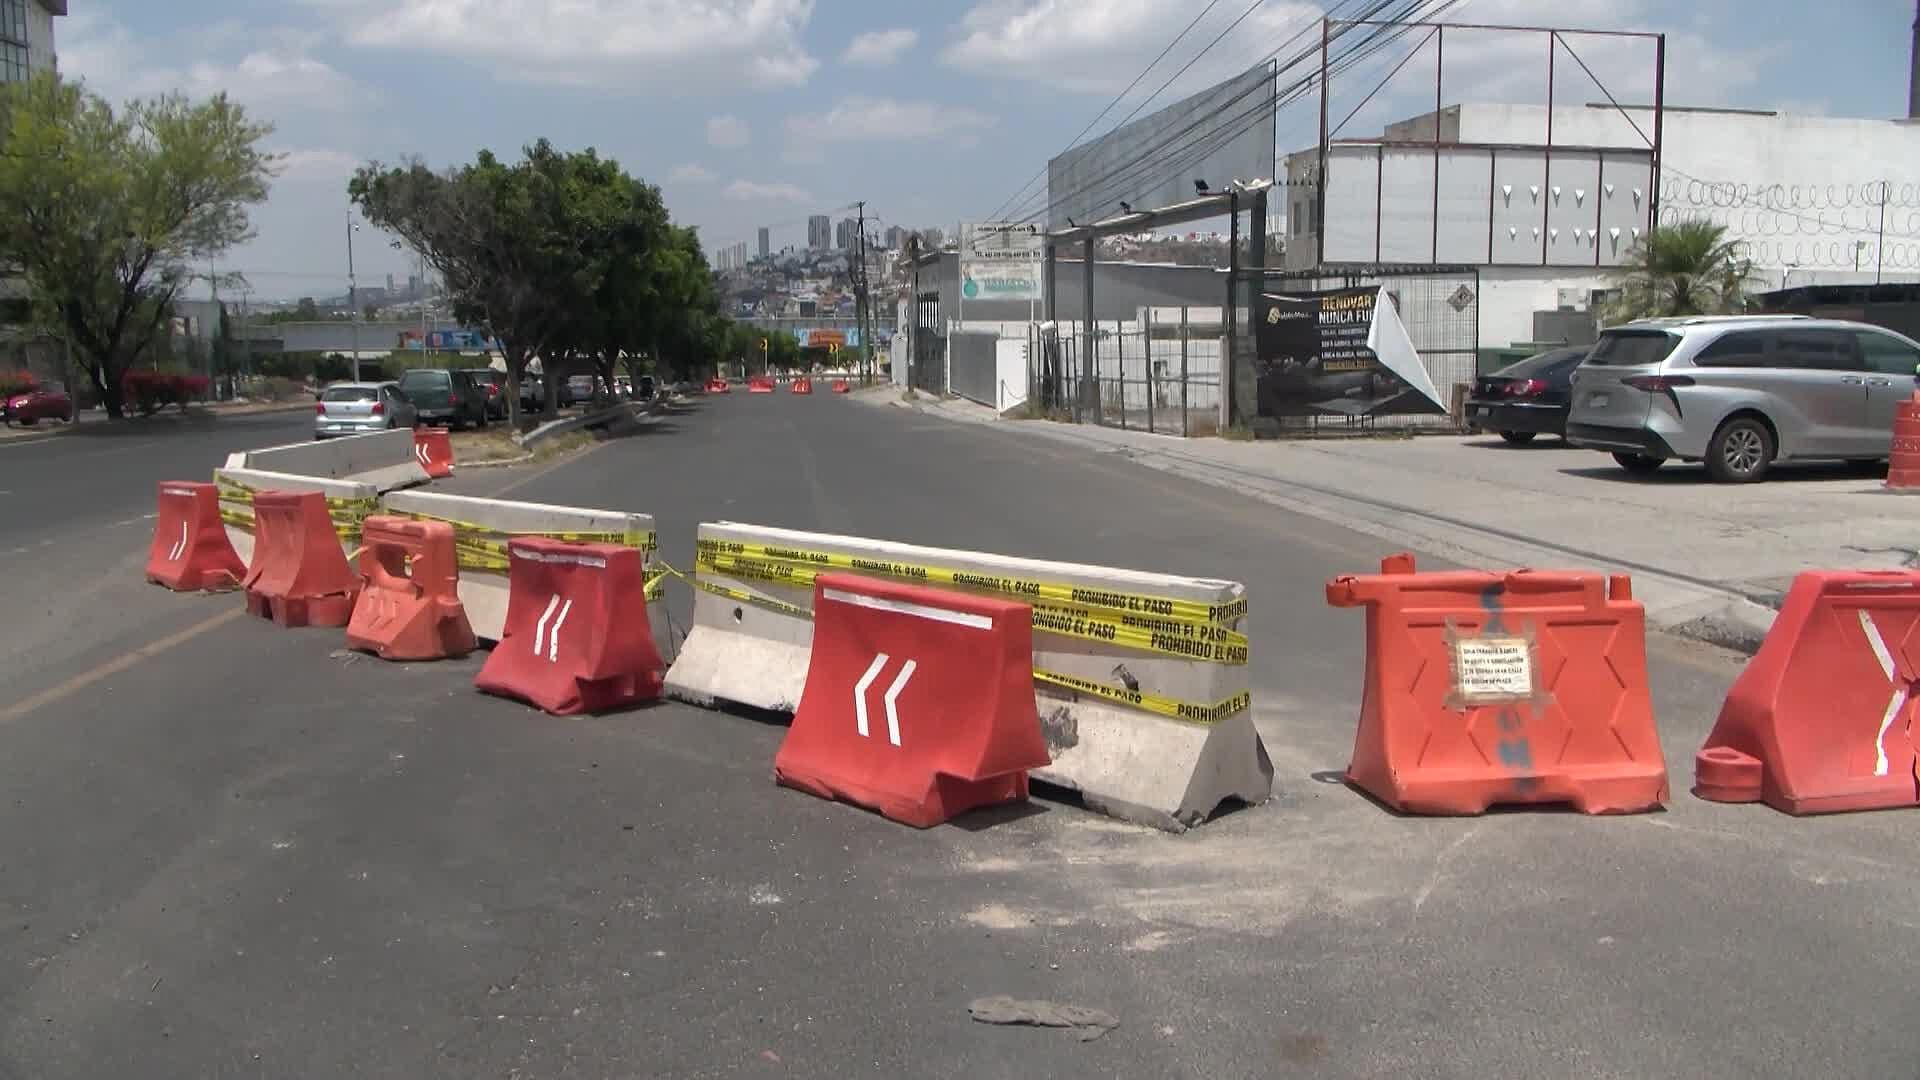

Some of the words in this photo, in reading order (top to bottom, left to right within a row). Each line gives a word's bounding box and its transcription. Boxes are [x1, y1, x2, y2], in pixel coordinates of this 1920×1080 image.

[1322, 295, 1371, 310] RENOVAR
[1318, 311, 1353, 324] NUNCA
[1072, 588, 1127, 609] PROHIBIDO
[1129, 597, 1140, 611] EL
[1144, 598, 1173, 616] PASO
[1074, 619, 1085, 634] EL
[1088, 621, 1116, 641] PASO
[1200, 625, 1228, 643] PASO
[1151, 632, 1212, 659] PROHIBIDO
[1215, 645, 1225, 660] EL
[1227, 646, 1248, 662] PASO
